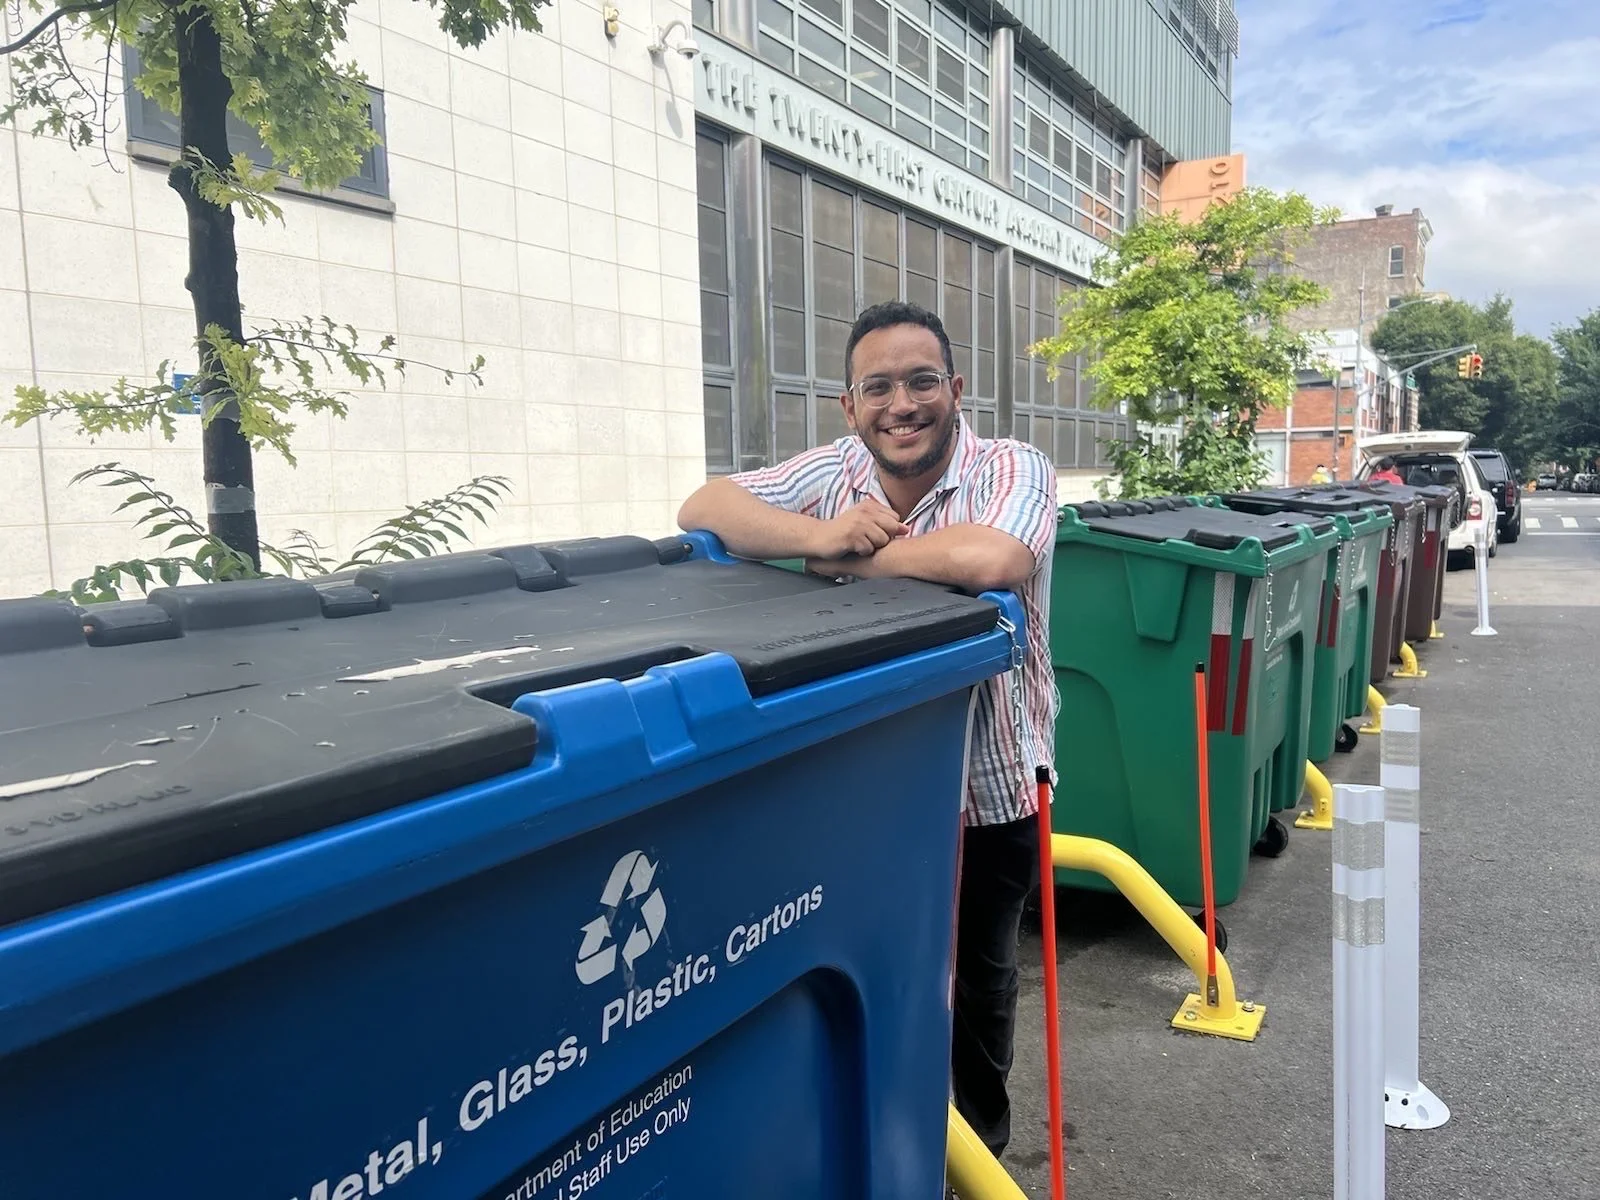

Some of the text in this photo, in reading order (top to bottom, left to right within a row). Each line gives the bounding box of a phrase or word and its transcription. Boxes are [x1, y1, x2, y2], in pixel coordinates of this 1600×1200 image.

[701, 54, 757, 113] THE
[768, 87, 926, 192] TWENTY-FIRST
[933, 169, 999, 227] CENTURY
[459, 1035, 588, 1132] Glass,
[602, 954, 716, 1043] Plastic,
[725, 884, 823, 963] Cartons
[569, 1149, 613, 1200] Staff
[616, 1129, 650, 1165] Use
[653, 1096, 692, 1136] Only
[587, 1120, 605, 1151] of
[610, 1063, 693, 1136] Education
